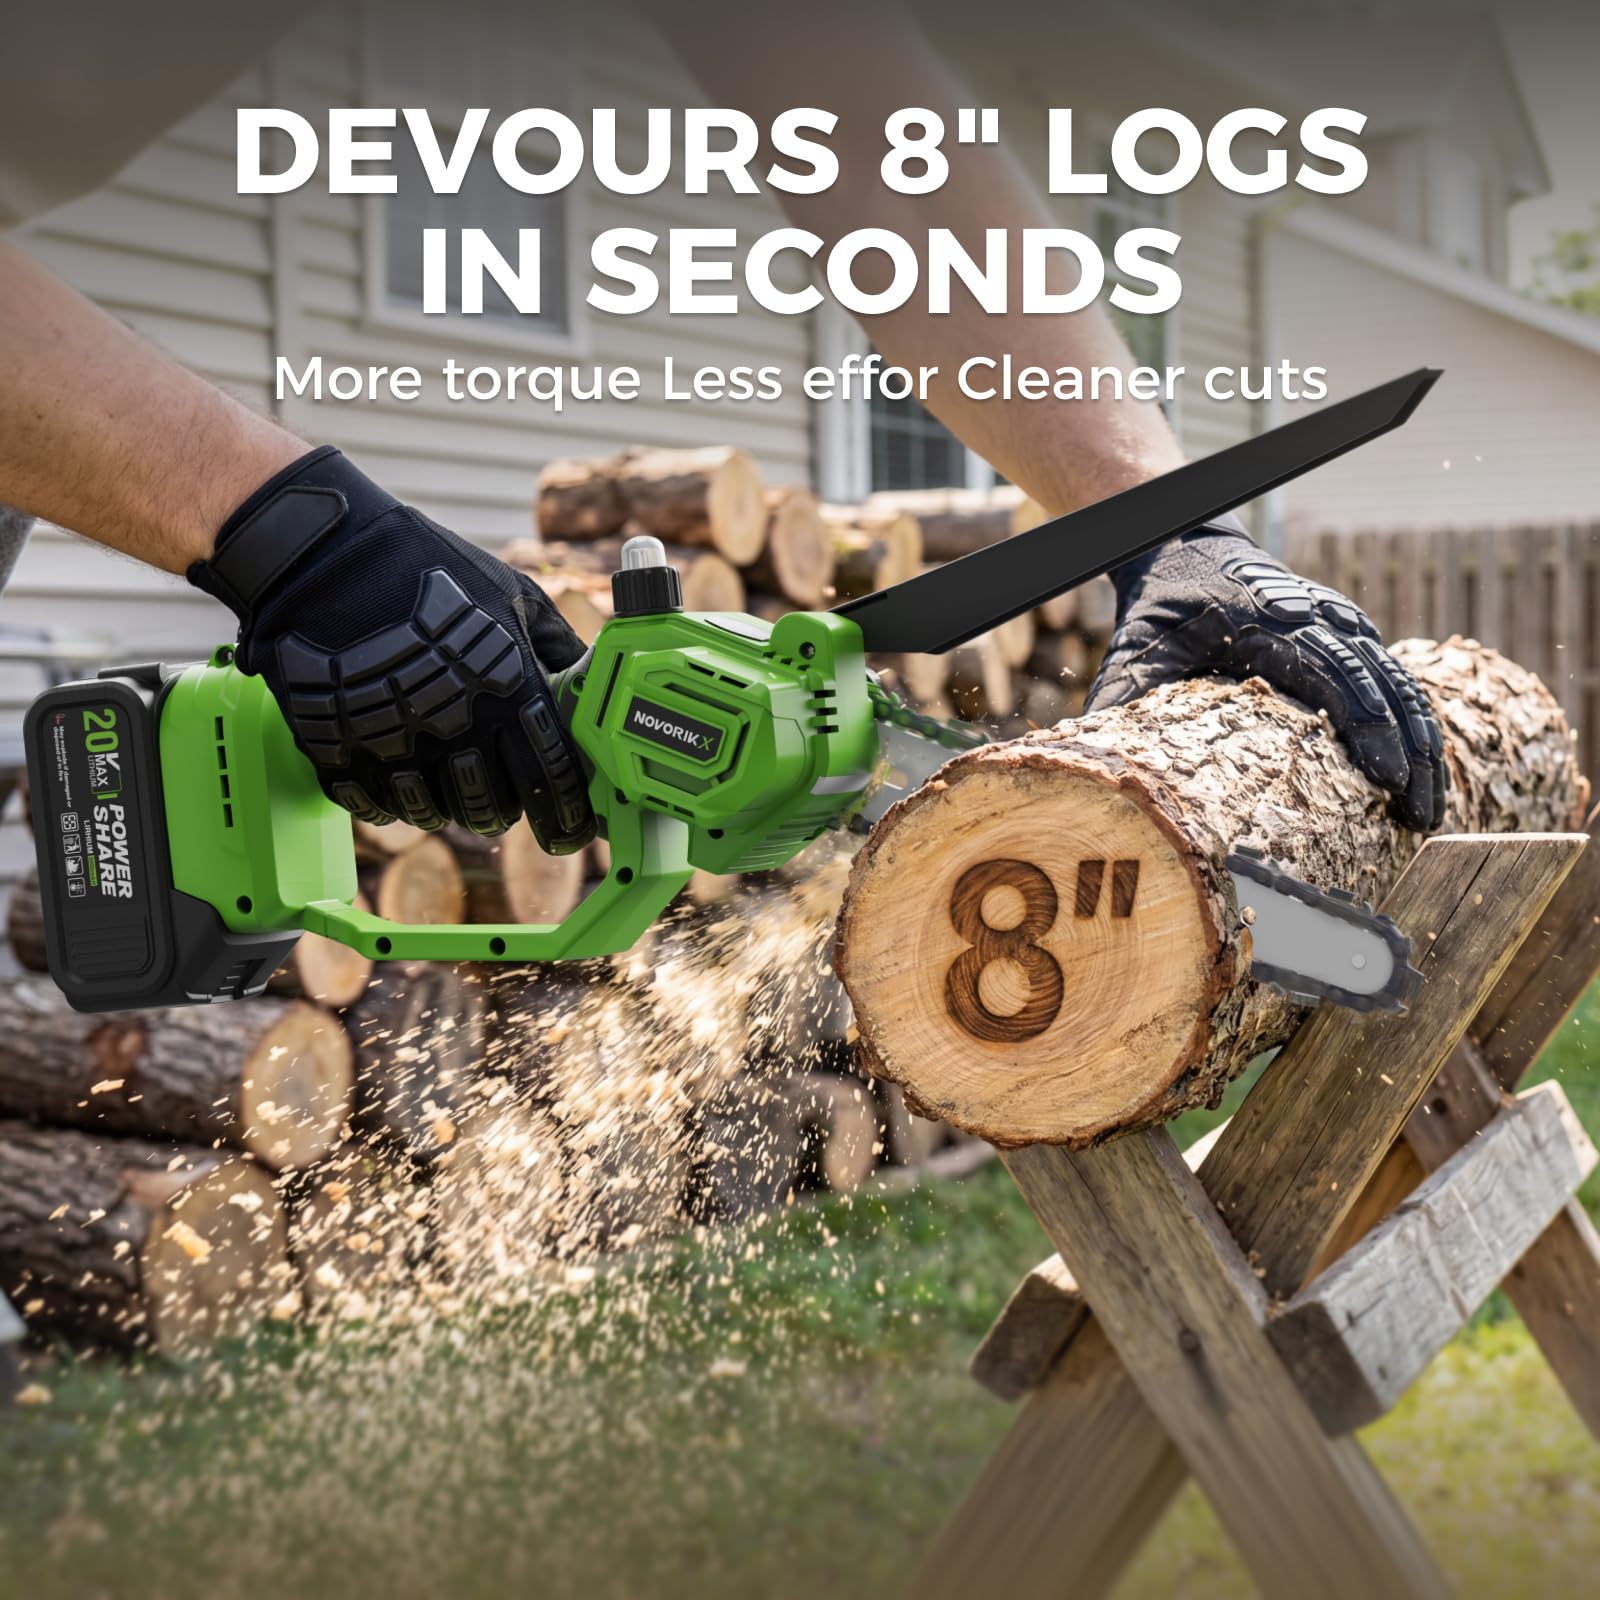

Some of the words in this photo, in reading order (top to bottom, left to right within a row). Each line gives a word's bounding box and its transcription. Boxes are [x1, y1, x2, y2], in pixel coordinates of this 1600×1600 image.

[94, 753, 109, 787] MAX
[93, 805, 117, 897] SHARE
[109, 803, 133, 899] POWER
[944, 858, 1140, 1044] 8"
